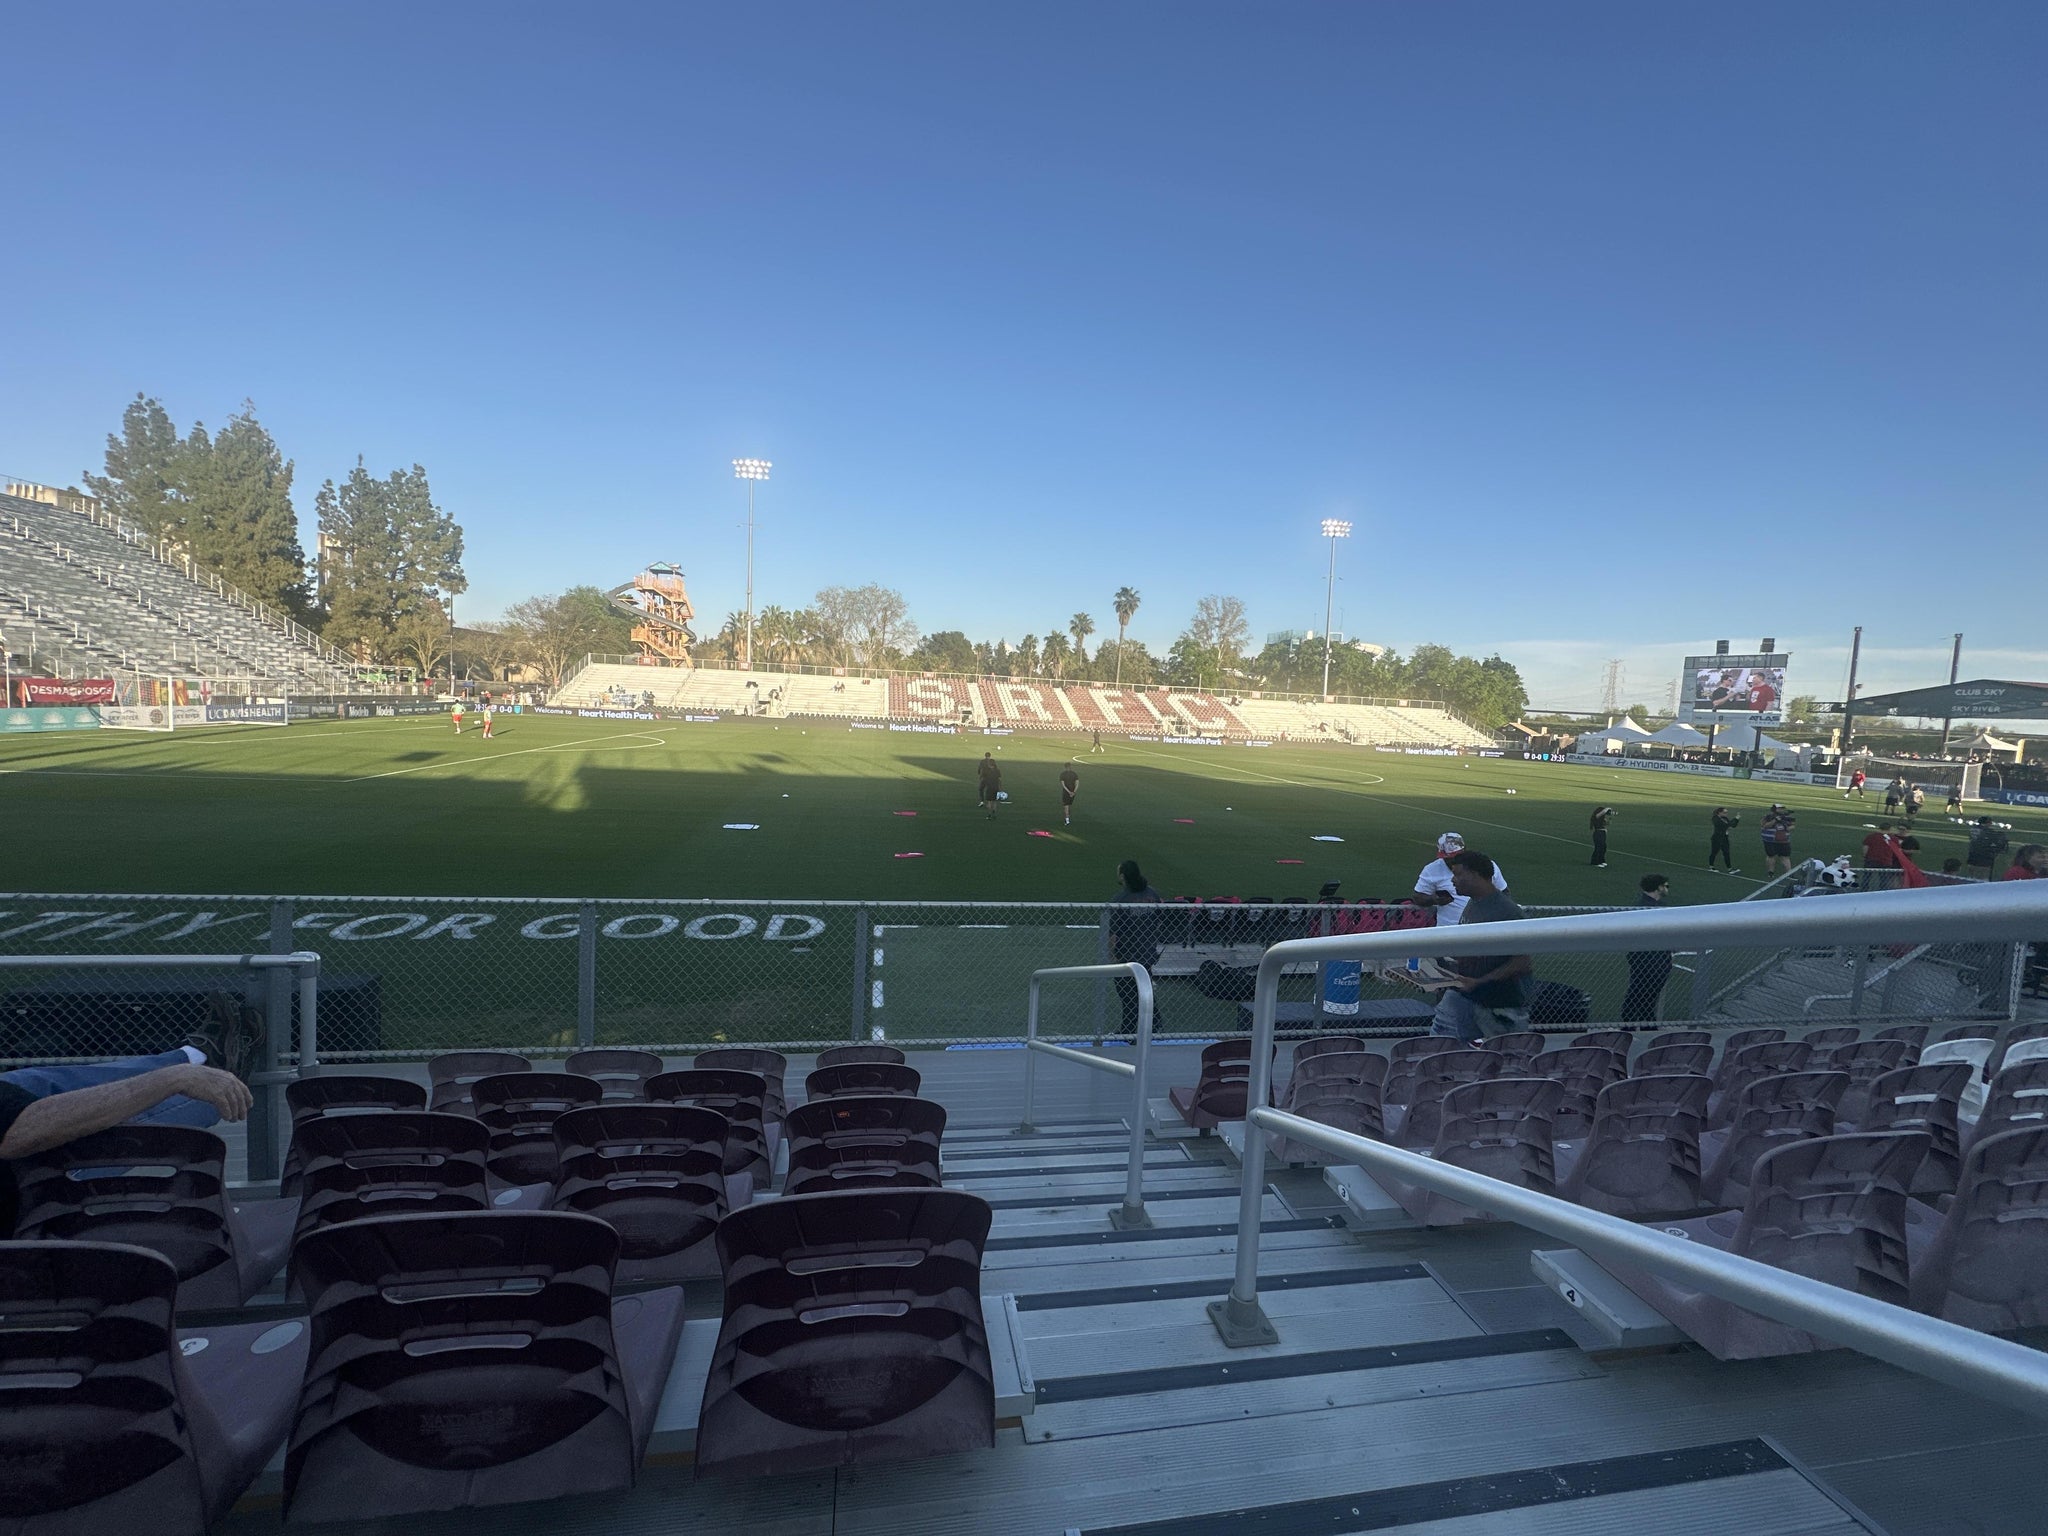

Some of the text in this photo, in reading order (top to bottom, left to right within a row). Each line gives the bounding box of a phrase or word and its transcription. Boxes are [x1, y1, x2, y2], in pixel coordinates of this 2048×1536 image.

[1954, 688, 2006, 696] CLUB SKY
[249, 706, 281, 718] HEALTH
[499, 705, 512, 713] 0-0
[534, 706, 564, 714] Welcome
[578, 709, 603, 718] Heart
[604, 710, 633, 719] Health
[634, 711, 654, 720] Park
[1972, 705, 2001, 713] RIVER
[889, 723, 911, 732] Heart
[912, 724, 937, 733] Health
[938, 726, 956, 734] Park
[1163, 736, 1182, 744] Heart
[1183, 737, 1205, 745] Health
[1206, 738, 1222, 746] Park
[1405, 747, 1423, 755] Heart
[1423, 748, 1443, 756] Health
[1444, 748, 1459, 757] Park
[1550, 753, 1565, 763] 29:35
[1630, 760, 1668, 770] HYUNDAI
[2006, 792, 2048, 805] UCDA
[0, 911, 264, 941] THY
[520, 913, 826, 940] GOOD
[1566, 1289, 1576, 1302] 4
